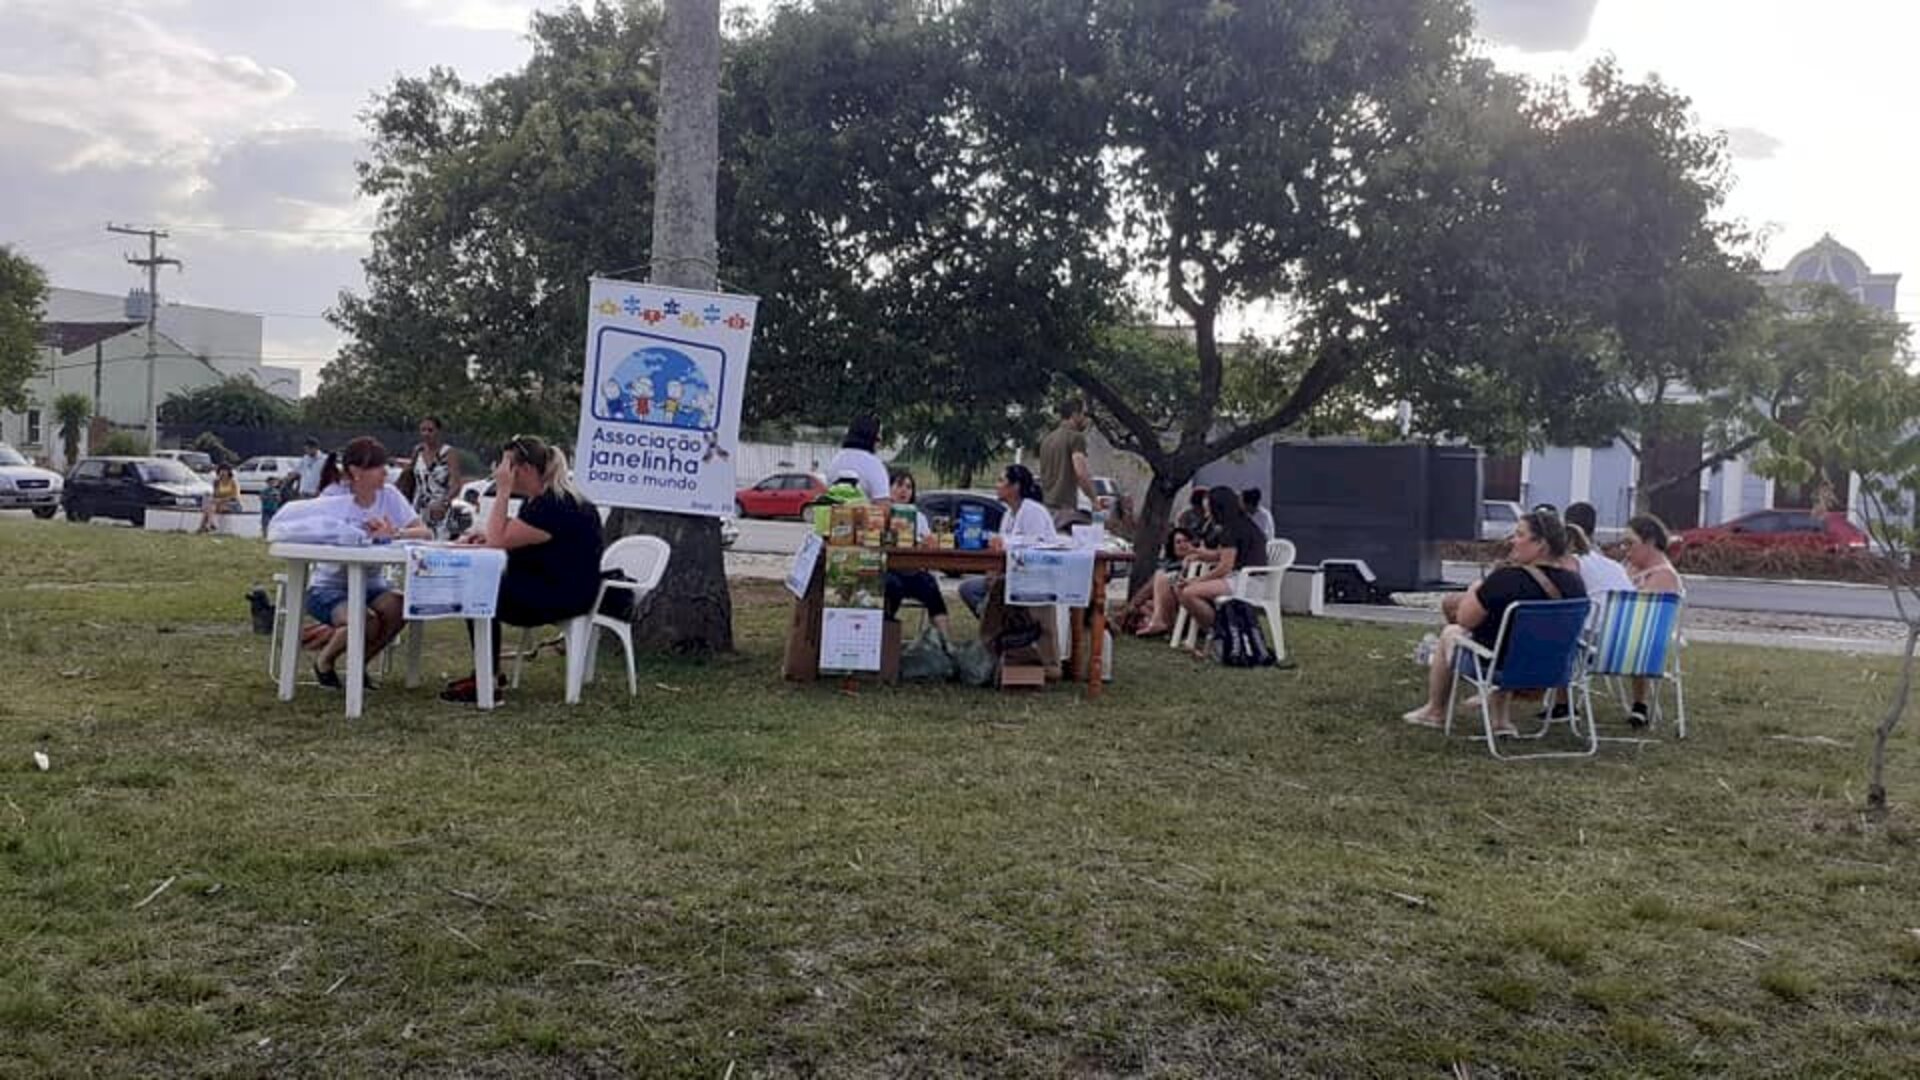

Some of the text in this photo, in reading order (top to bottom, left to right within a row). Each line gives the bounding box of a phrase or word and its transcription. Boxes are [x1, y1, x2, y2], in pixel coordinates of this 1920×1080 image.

[592, 427, 701, 453] Associação
[589, 444, 699, 475] janelinha
[589, 470, 697, 491] para o mundo
